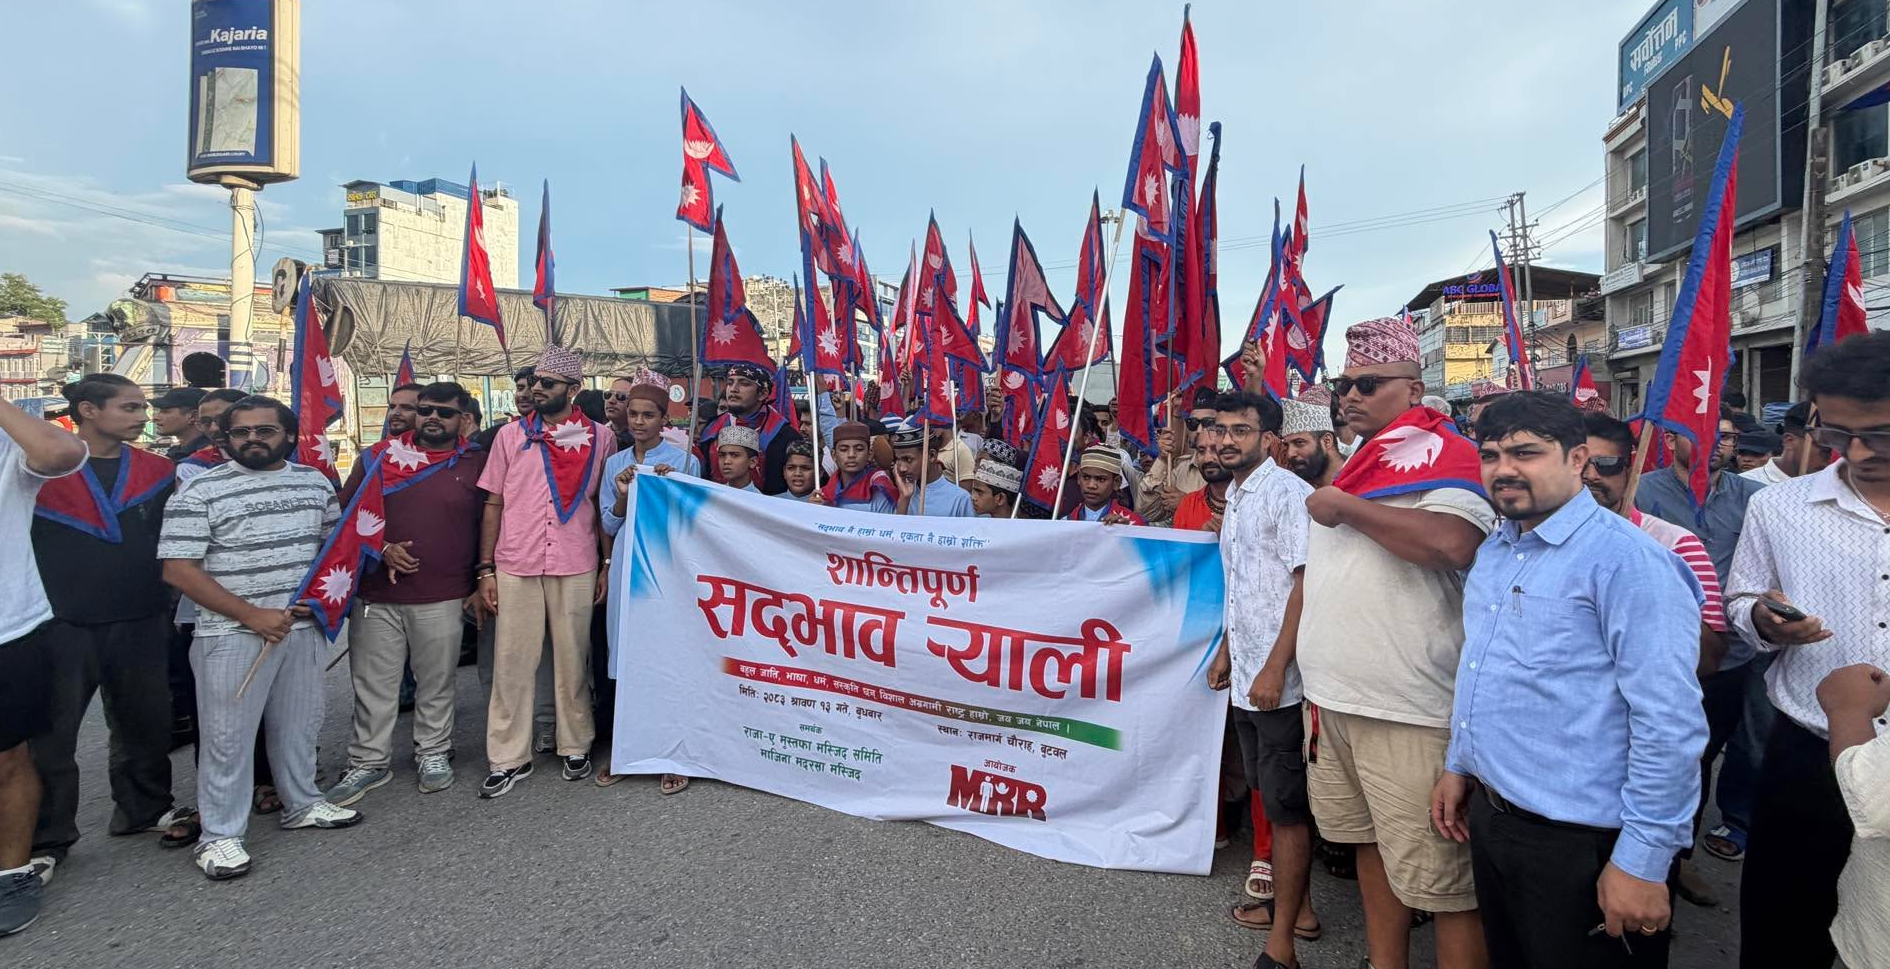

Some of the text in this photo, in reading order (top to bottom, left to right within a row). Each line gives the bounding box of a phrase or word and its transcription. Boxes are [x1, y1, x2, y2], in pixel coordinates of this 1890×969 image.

[210, 26, 268, 44] Kajaria
[1443, 285, 1463, 295] ABC
[857, 527, 876, 536] हाम्रो
[900, 531, 924, 543] एकता
[927, 531, 934, 543] नै
[938, 534, 957, 546] हाम्रो
[826, 551, 980, 609] शान्तिपूर्ण
[760, 667, 781, 681] जाति,
[879, 689, 905, 704] विशाल
[946, 704, 966, 720] राष्ट्र
[996, 714, 1012, 724] जय
[1016, 717, 1032, 727] जय
[1036, 718, 1060, 731] नेपाल
[763, 692, 786, 706] २०८३
[791, 696, 816, 710] श्रावण
[820, 700, 831, 713] १३
[836, 701, 851, 716] गते,
[743, 726, 884, 764] राजा-ए मुस्तफा मस्जिद समिति
[936, 724, 1068, 760] स्थान: राजमार्ग चौराह, बुटवल
[796, 756, 826, 772] मदरसा
[830, 763, 862, 781] मस्जिद
[984, 758, 1017, 774] आयोजक
